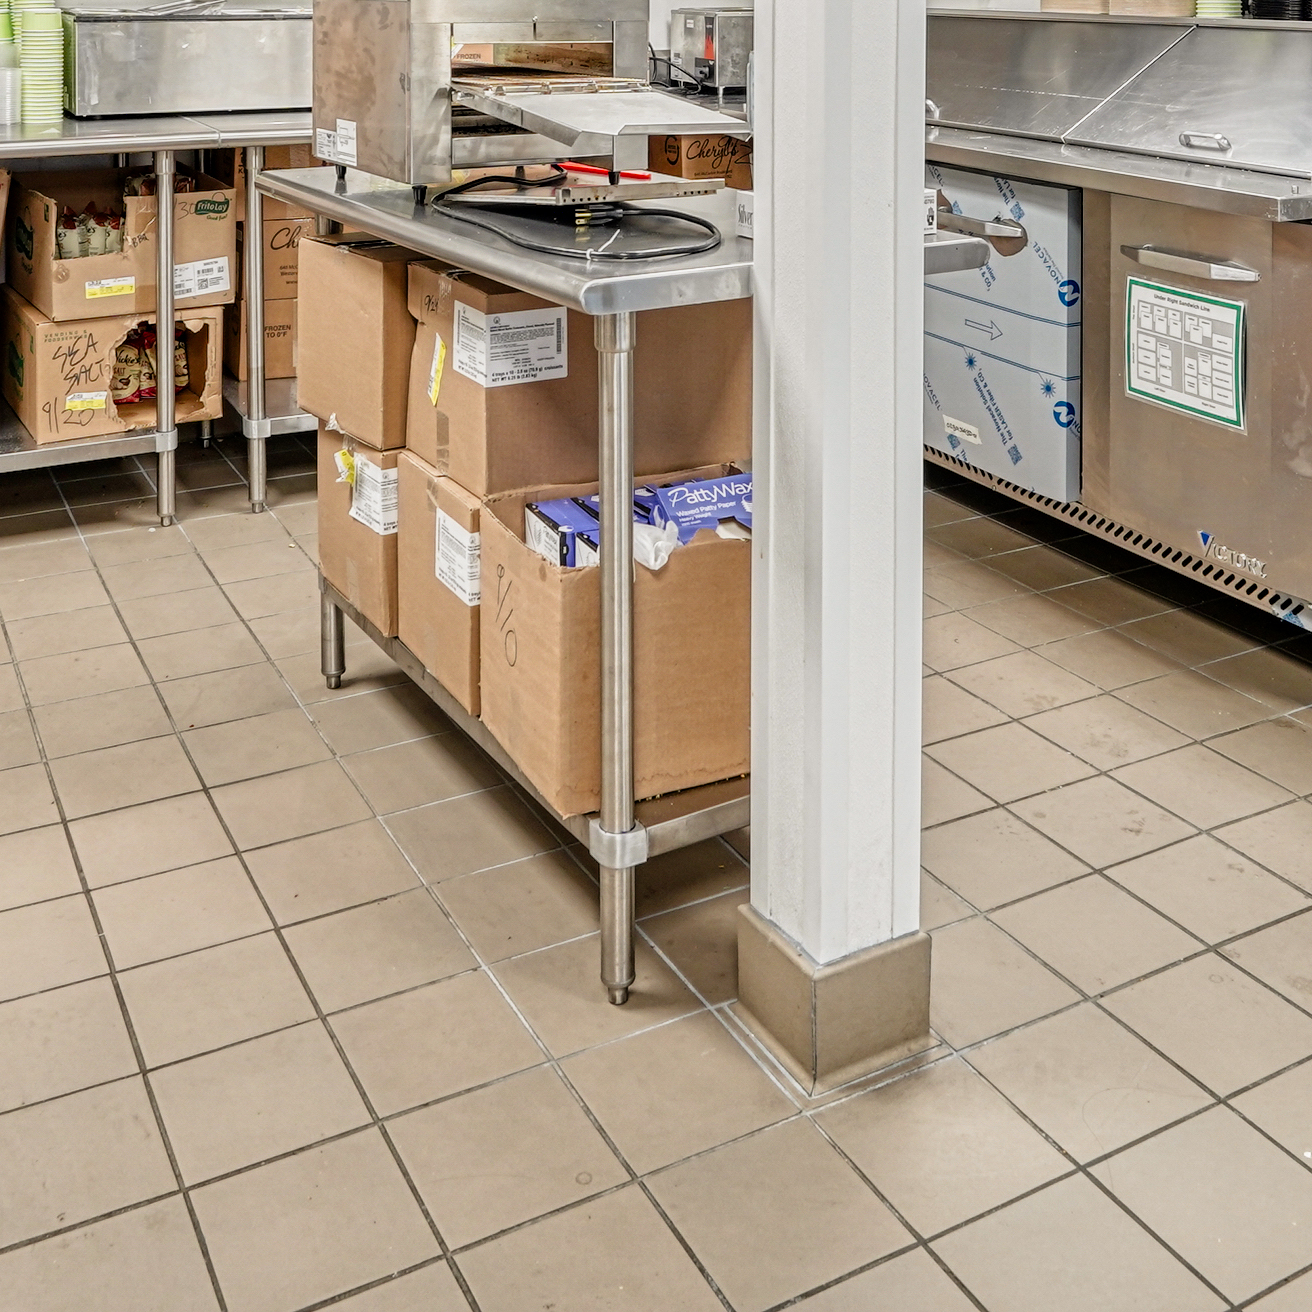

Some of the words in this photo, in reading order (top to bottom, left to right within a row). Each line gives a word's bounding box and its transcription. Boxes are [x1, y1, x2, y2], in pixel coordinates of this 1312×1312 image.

[1033, 241, 1062, 285] NOVACEL
[1154, 293, 1167, 302] Under
[1167, 296, 1179, 306] Right
[1179, 299, 1200, 310] Sandwich
[1200, 304, 1210, 313] Line
[264, 324, 292, 333] FROZEN
[52, 333, 98, 374] SEA
[63, 358, 105, 395] SALT
[42, 397, 96, 434] 9/20
[667, 480, 752, 508] PattyWax
[676, 508, 699, 517] Waxed
[699, 504, 717, 515] Patty
[717, 500, 737, 511] Paper
[694, 512, 711, 520] Weight
[1197, 530, 1268, 578] VICTORY
